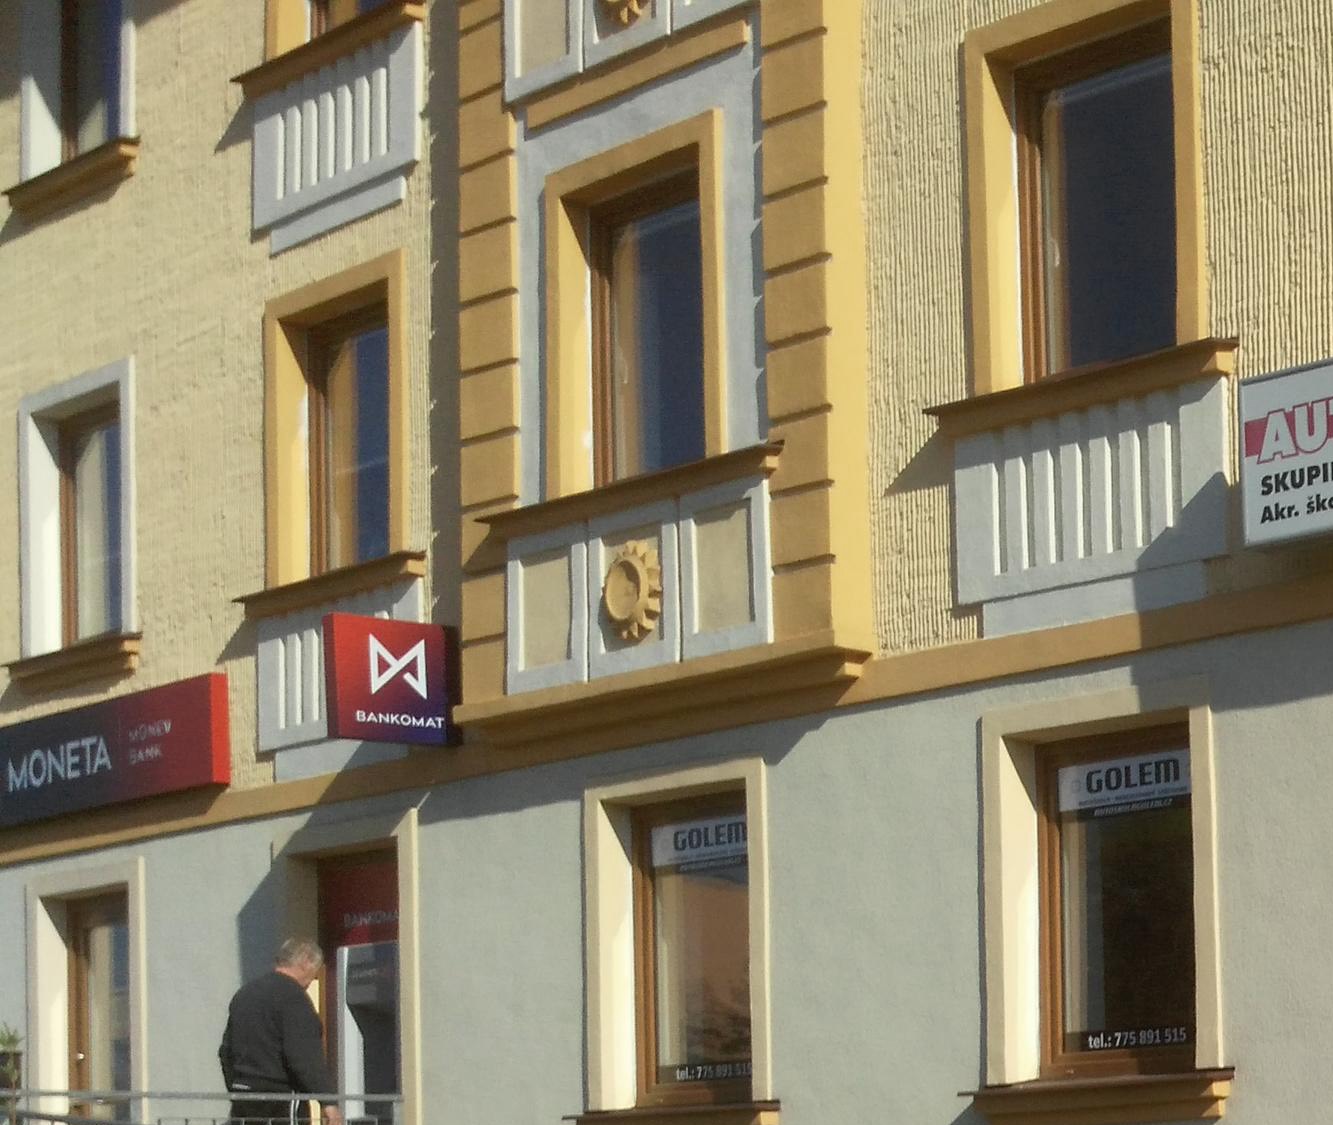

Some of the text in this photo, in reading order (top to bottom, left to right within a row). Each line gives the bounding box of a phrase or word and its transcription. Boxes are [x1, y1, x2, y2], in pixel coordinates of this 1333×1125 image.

[1260, 501, 1300, 524] Akr.
[356, 710, 445, 729] BANKOMAT
[7, 735, 112, 793] MONETA
[1086, 758, 1180, 794] GOLEM
[673, 822, 747, 851] GOLEM
[1088, 1027, 1186, 1049] tel.: 775 891 515
